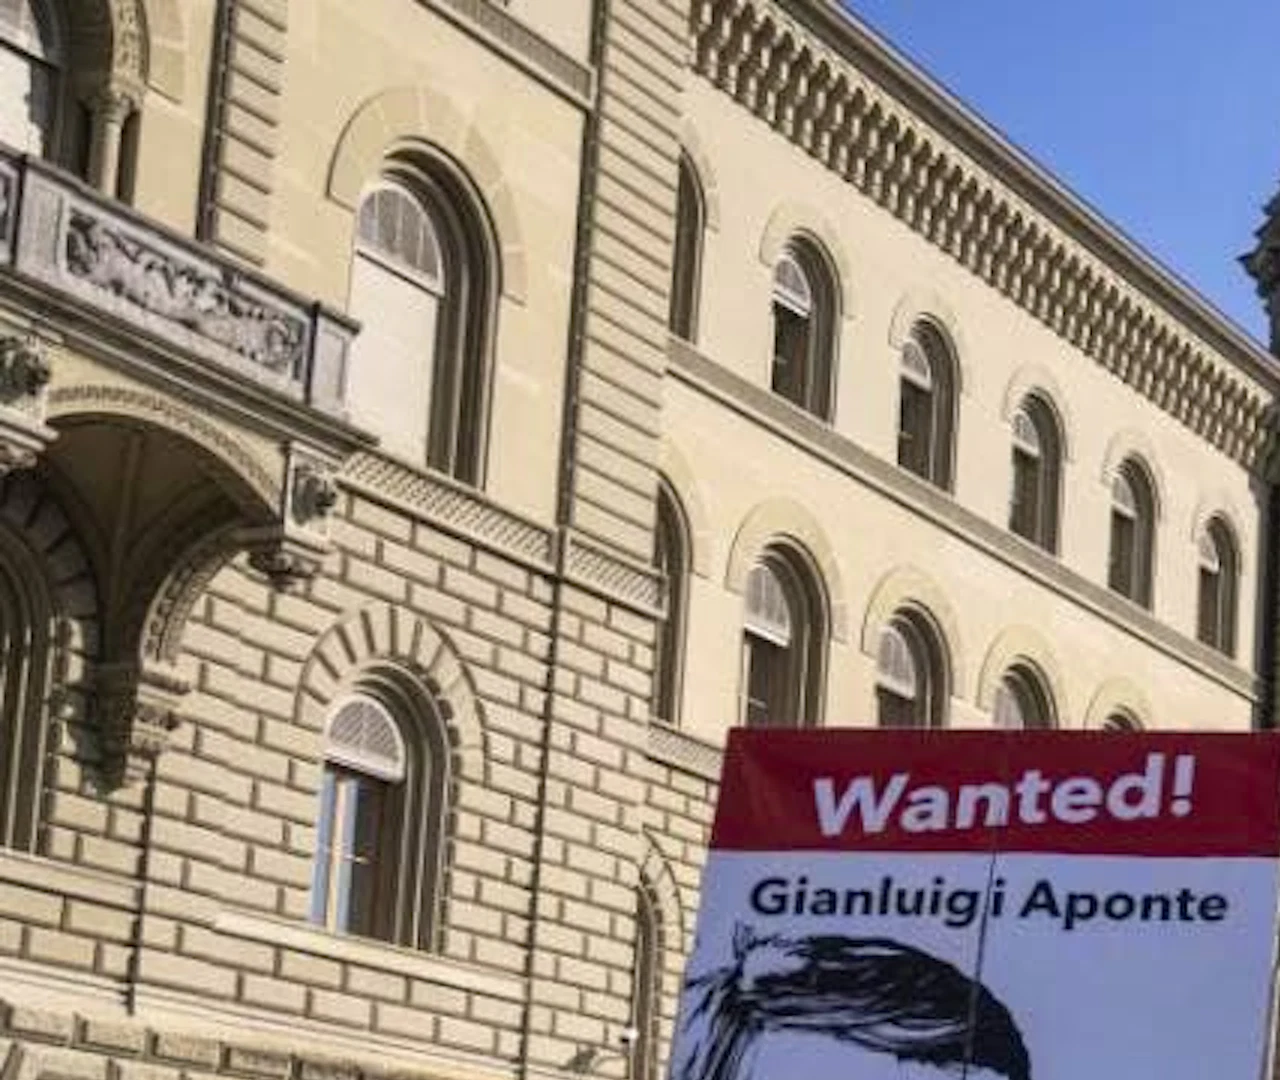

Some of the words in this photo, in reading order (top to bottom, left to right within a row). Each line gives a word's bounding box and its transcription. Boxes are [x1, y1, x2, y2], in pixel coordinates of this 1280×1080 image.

[813, 753, 1195, 836] Wanted!
[749, 876, 1006, 928] Gianluigi
[1018, 879, 1229, 931] Aponte
